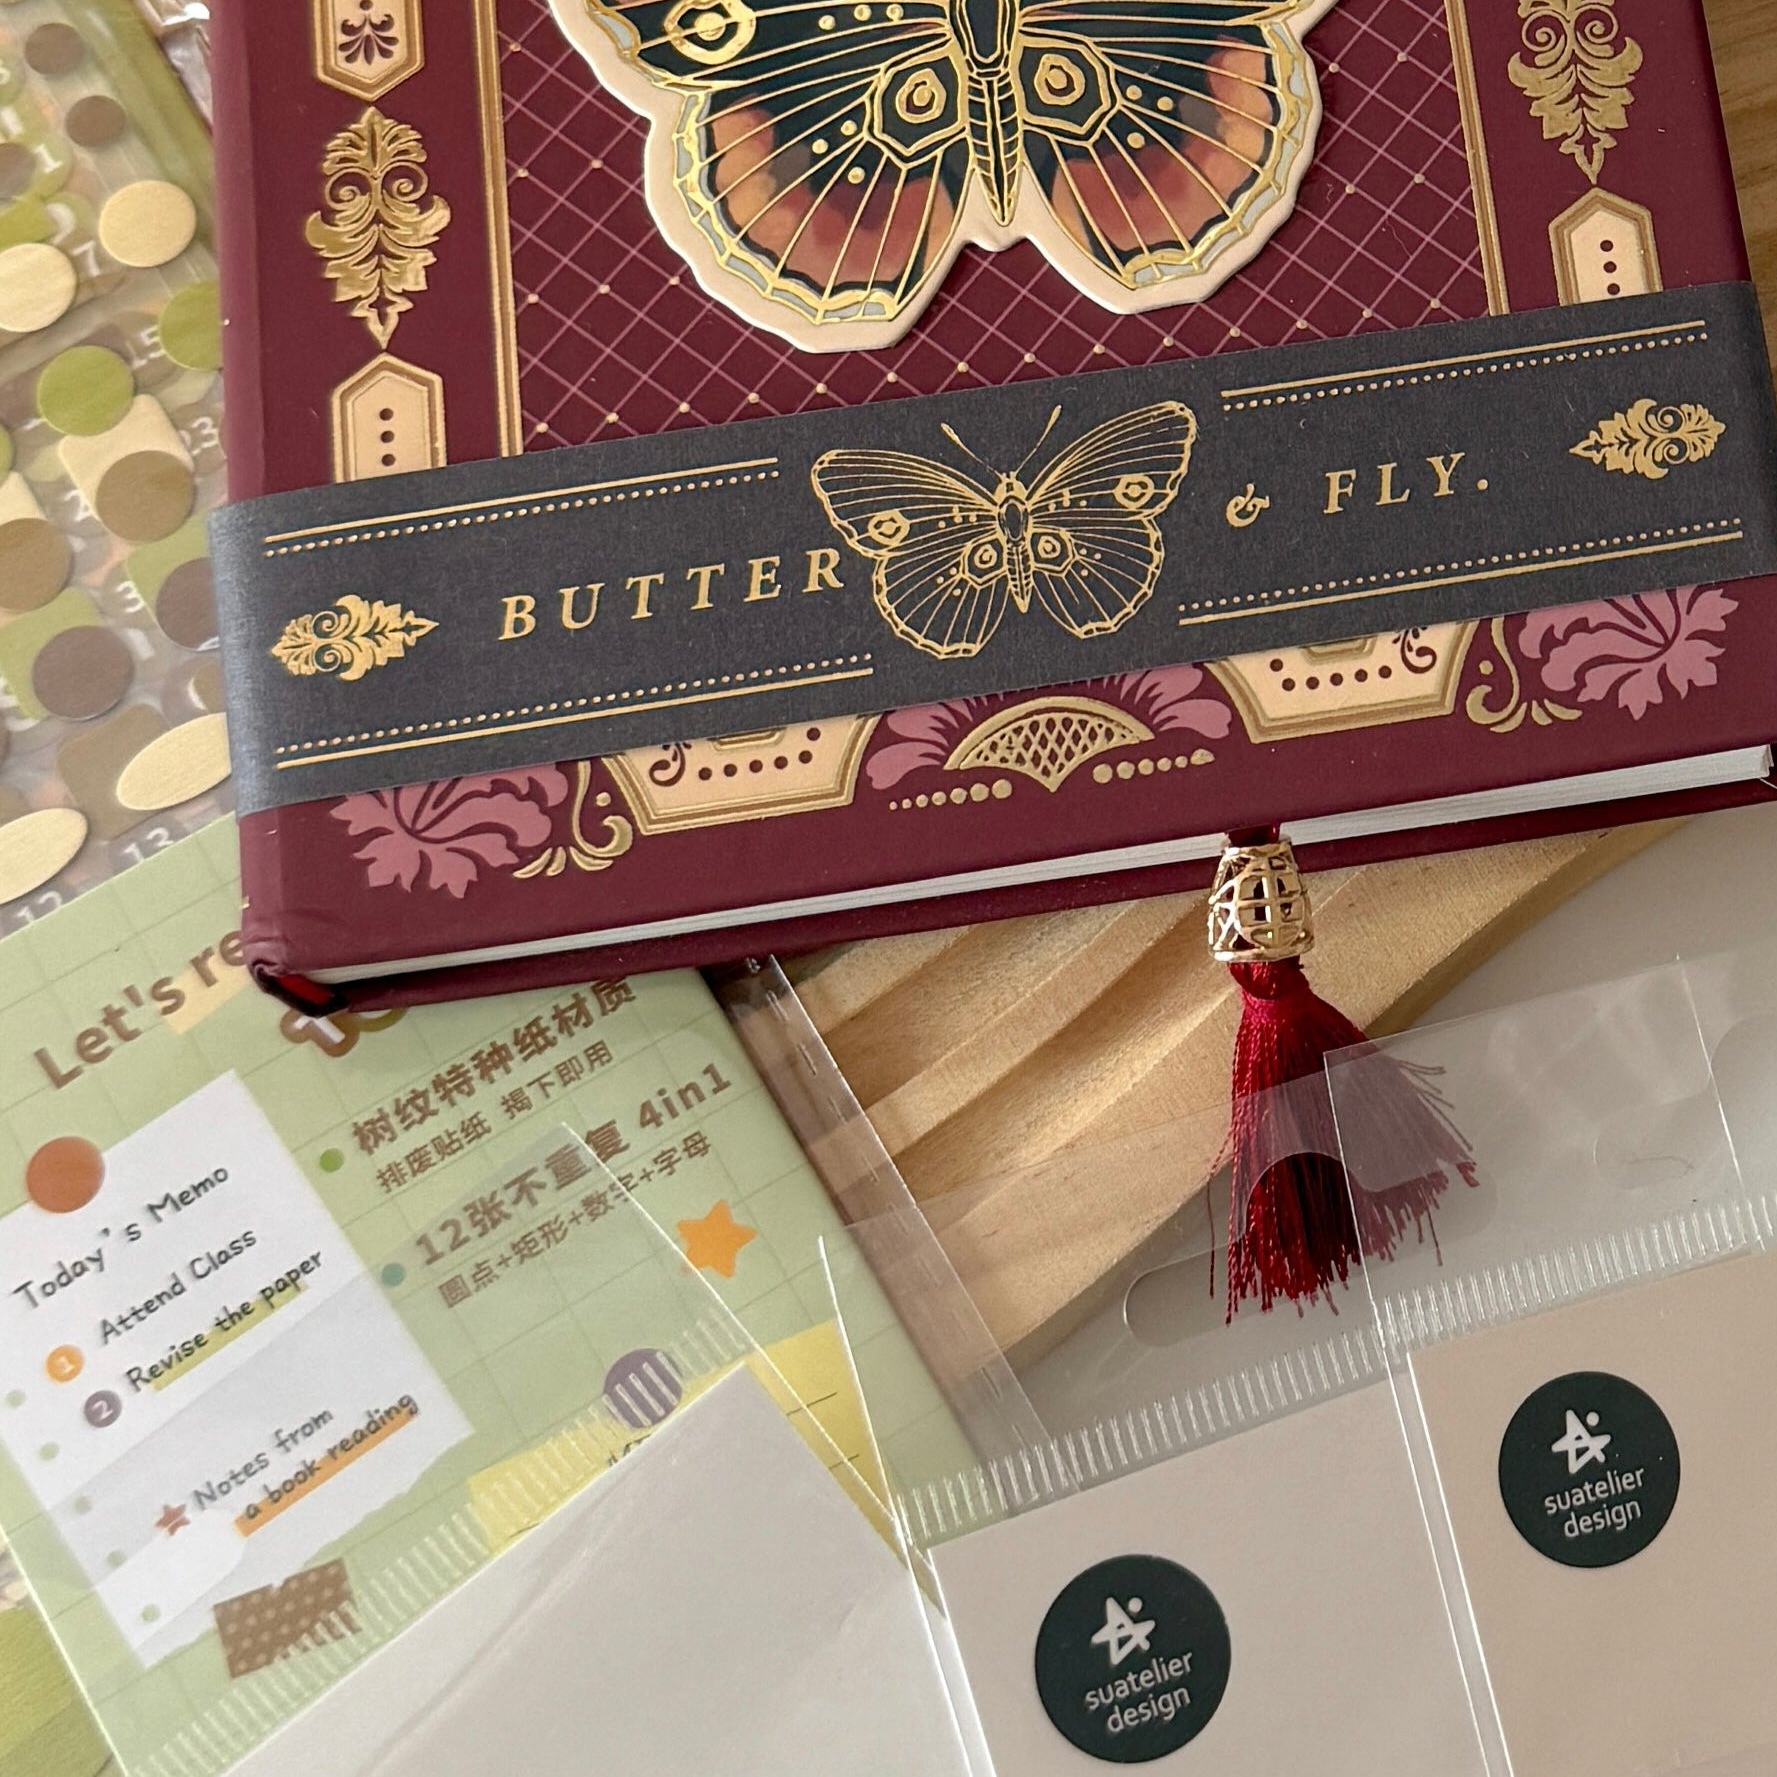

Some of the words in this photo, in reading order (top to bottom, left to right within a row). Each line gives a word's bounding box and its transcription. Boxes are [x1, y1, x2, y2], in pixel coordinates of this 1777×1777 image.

[499, 547, 846, 642] BUTTER
[1324, 448, 1491, 515] FLY.
[34, 975, 187, 1090] Let's
[351, 978, 637, 1156] 树纹特种纸材质
[376, 1110, 492, 1194] 排废贴纸
[500, 1038, 615, 1121] 揭下即用
[413, 1119, 632, 1266] 12张不重复
[638, 1062, 732, 1132] 4in1
[146, 1166, 230, 1224] Memo
[93, 1397, 116, 1421] 2
[125, 1329, 210, 1393] Revise
[214, 1299, 256, 1335] the
[259, 1248, 324, 1309] paper
[98, 1274, 187, 1345] Attend
[189, 1227, 258, 1281] Class
[191, 1449, 271, 1511] Notes
[274, 1407, 335, 1455] from
[243, 1500, 263, 1522] a
[267, 1457, 323, 1505] book
[325, 1393, 421, 1462] reading
[1543, 1464, 1645, 1516] suatelier
[1562, 1496, 1641, 1539] design
[1083, 1649, 1195, 1713] suatelier
[1105, 1682, 1191, 1734] design
